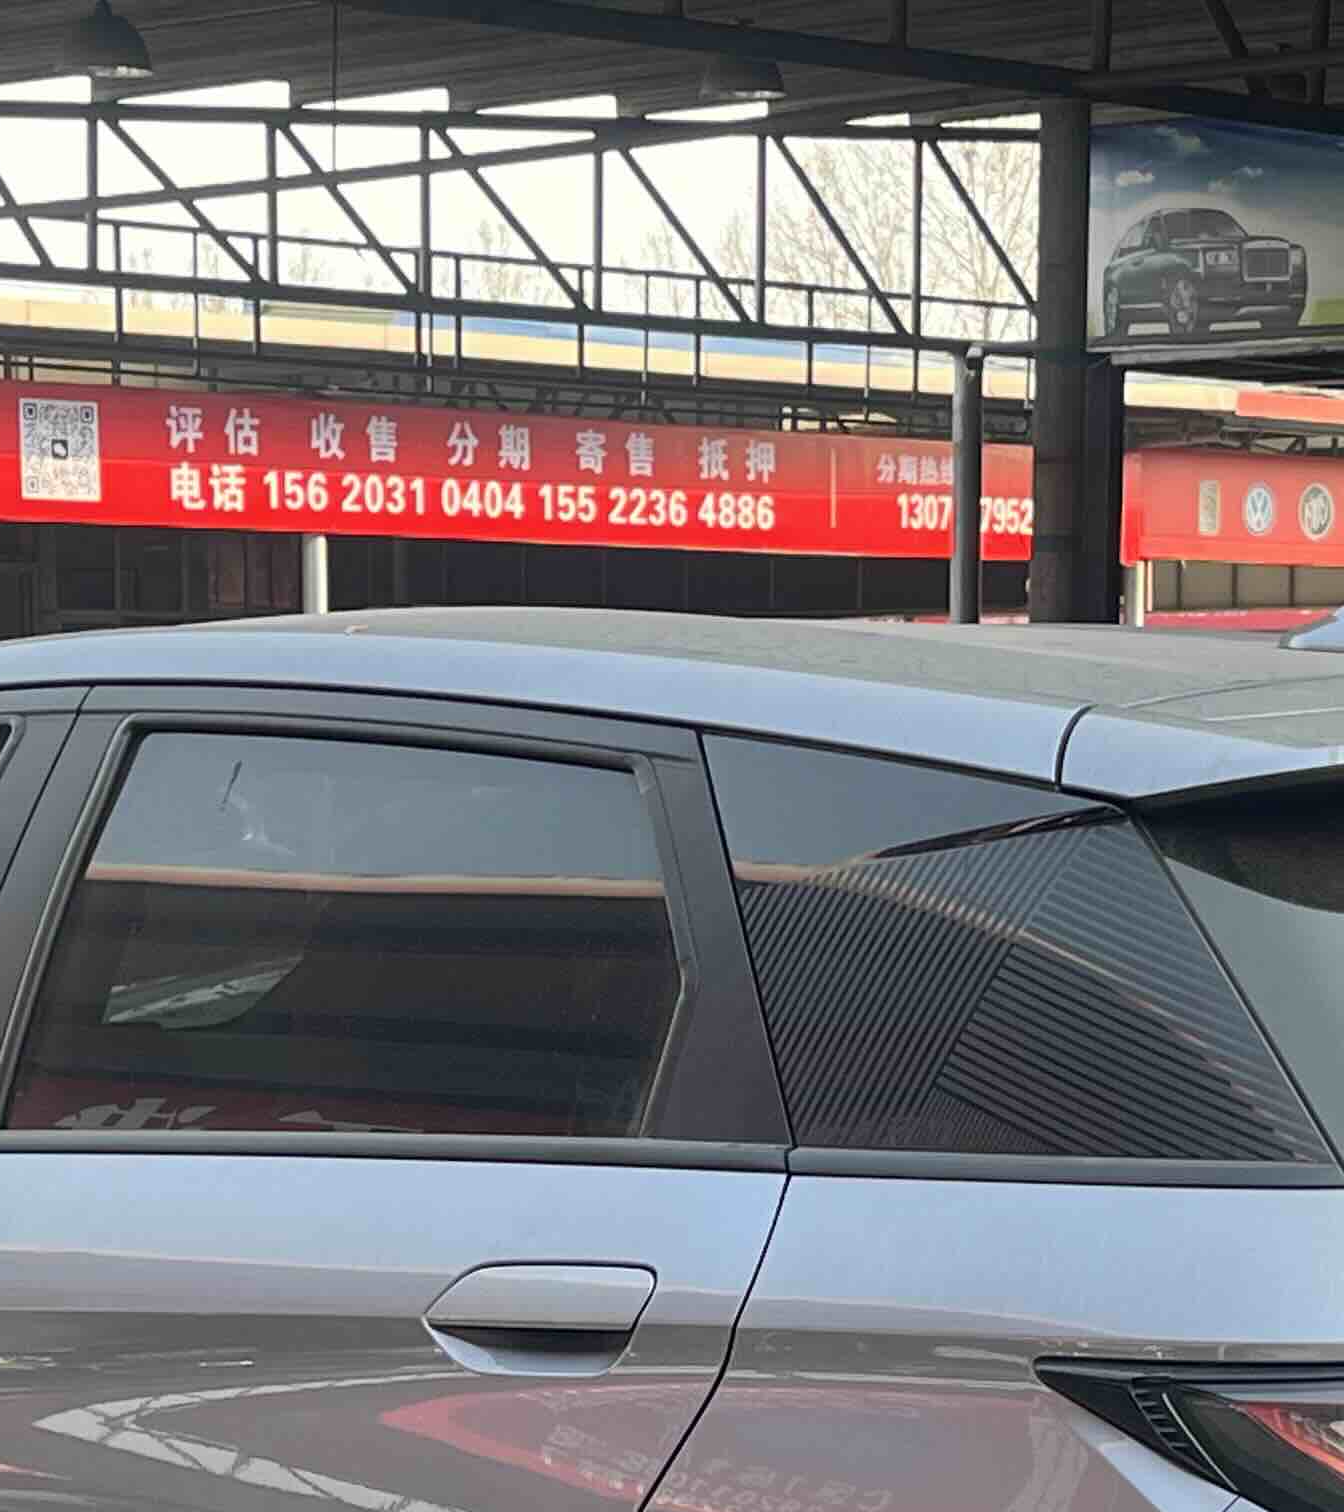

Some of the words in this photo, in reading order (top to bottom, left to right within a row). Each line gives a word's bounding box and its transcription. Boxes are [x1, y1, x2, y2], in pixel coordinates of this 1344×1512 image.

[166, 405, 260, 456] 评估
[311, 412, 399, 463] 收售
[447, 420, 531, 471] 分期
[575, 429, 656, 478] 寄售
[698, 436, 776, 484] 抵押
[169, 461, 247, 512] 电话
[263, 471, 329, 511] 156
[341, 474, 426, 515] 2031
[441, 477, 525, 520] 0404
[538, 483, 597, 523] 155
[608, 487, 689, 527] 2236
[698, 491, 775, 531] 4886
